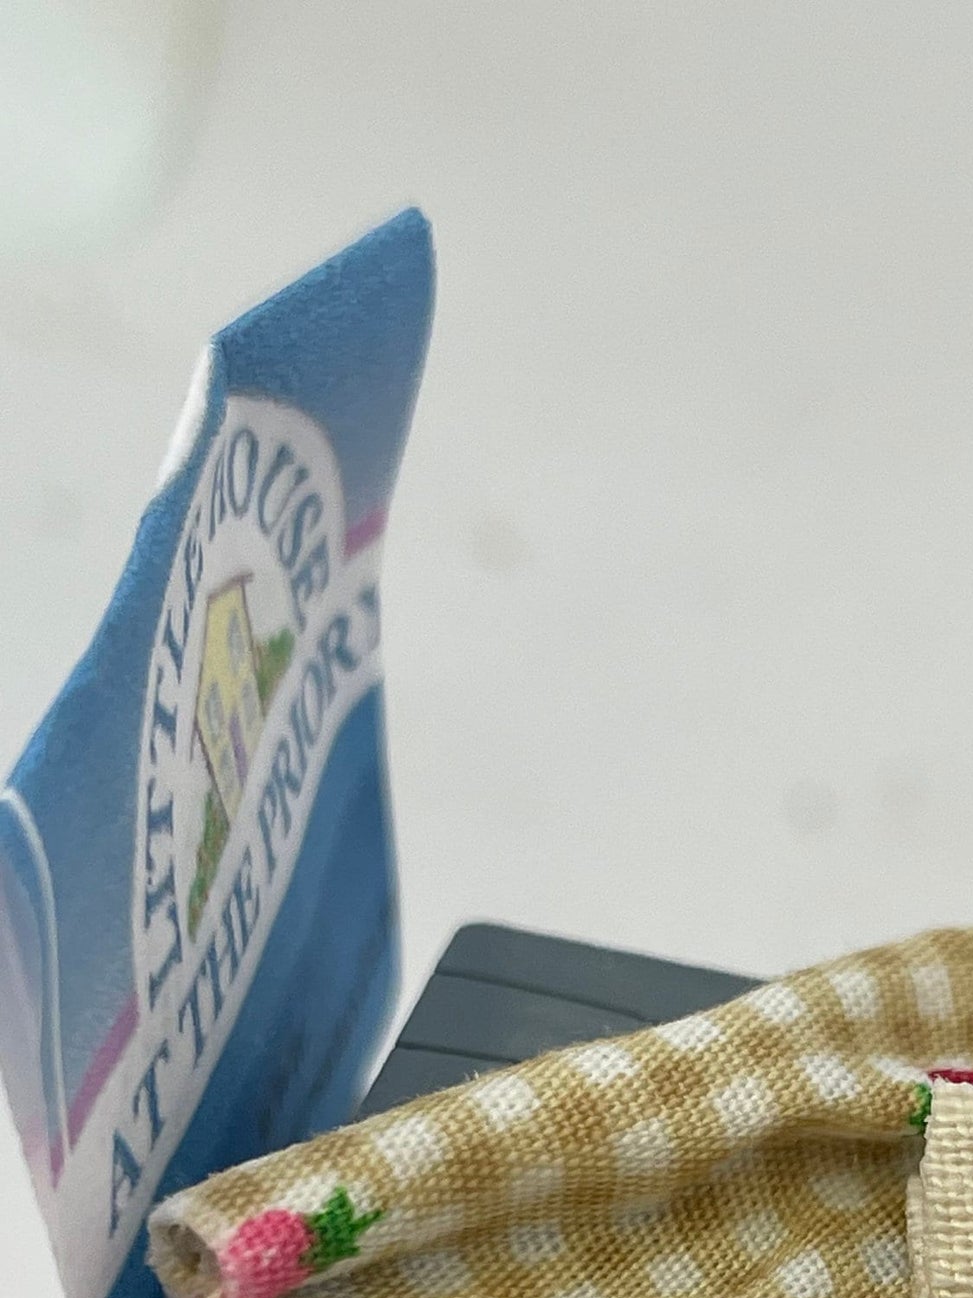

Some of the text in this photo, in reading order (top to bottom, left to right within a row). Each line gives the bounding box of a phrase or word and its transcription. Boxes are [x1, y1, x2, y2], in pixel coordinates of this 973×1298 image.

[144, 428, 330, 1012] LITTLE HOUSE
[109, 1037, 169, 1239] AT
[178, 847, 260, 1070] THE
